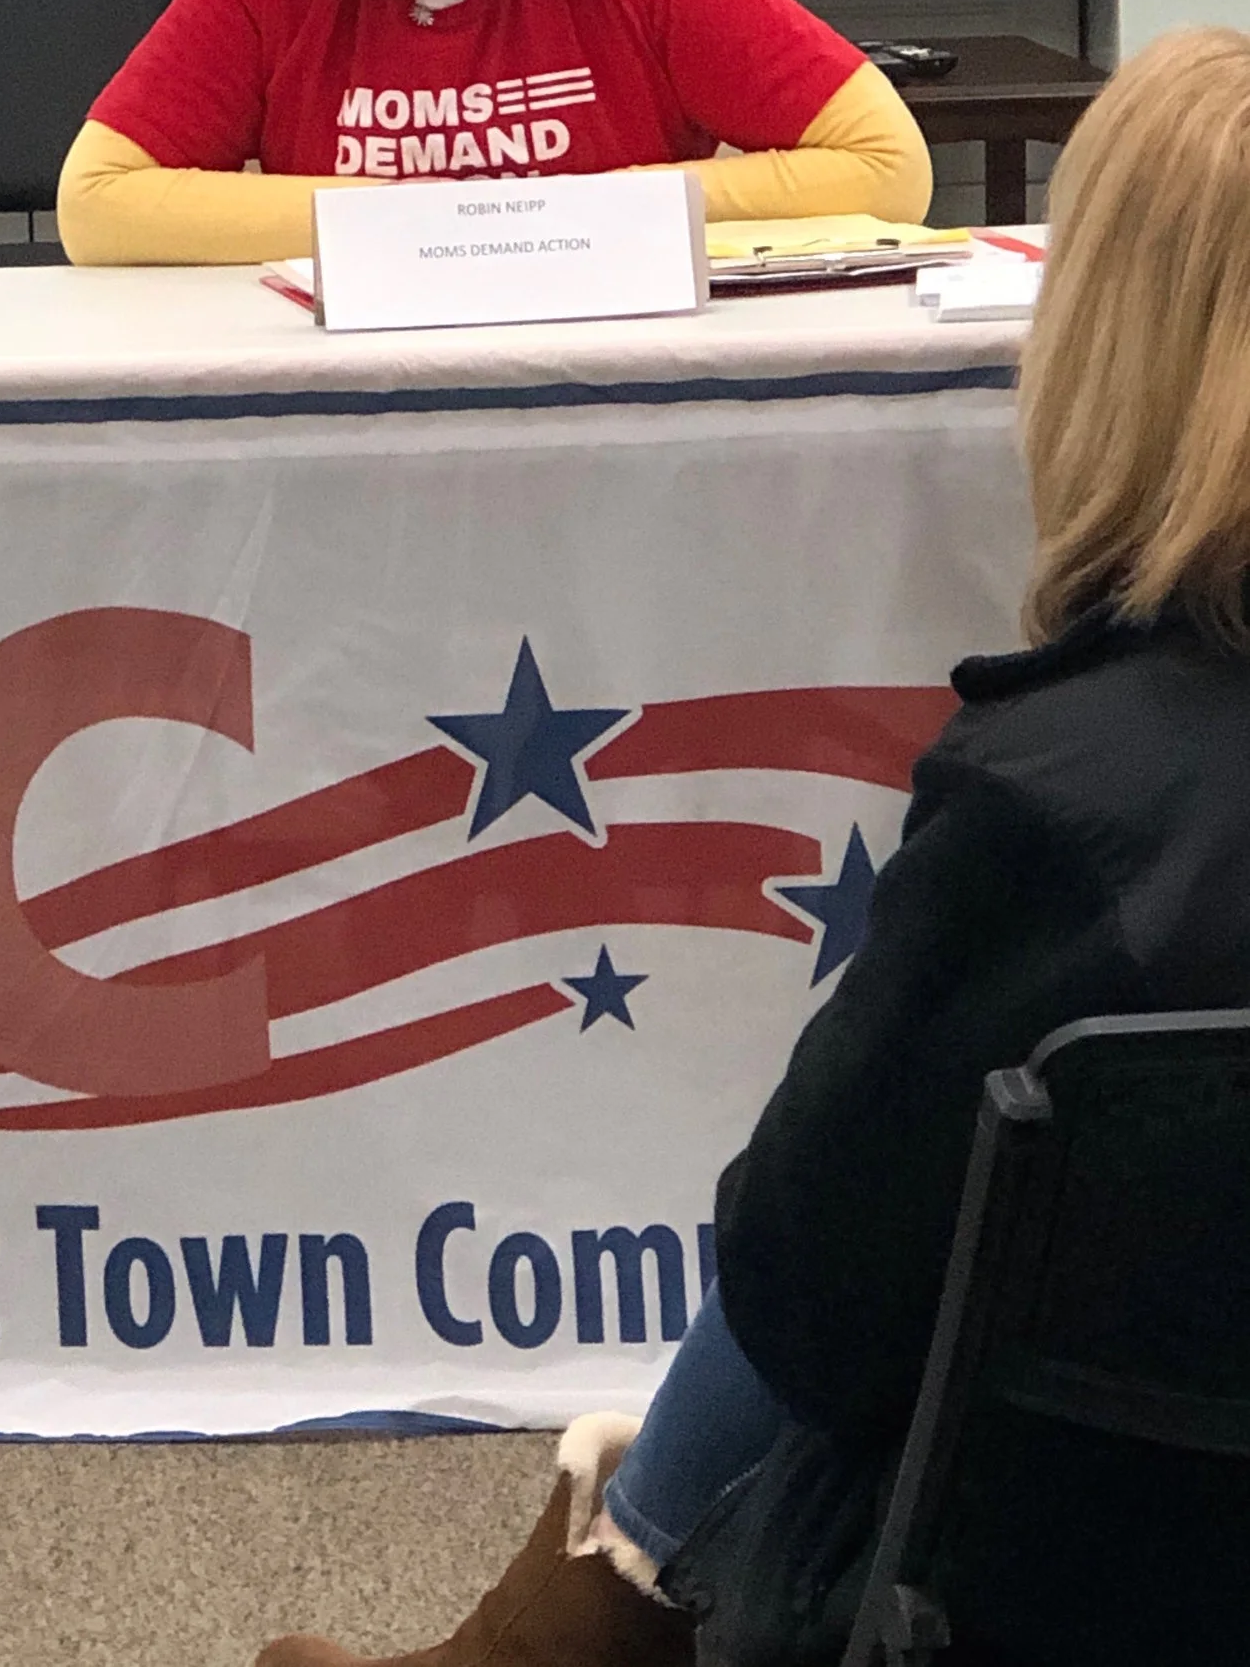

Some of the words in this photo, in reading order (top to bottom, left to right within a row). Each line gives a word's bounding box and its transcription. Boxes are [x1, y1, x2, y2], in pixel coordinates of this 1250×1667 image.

[337, 83, 494, 130] MOMS
[335, 118, 571, 176] DEMAND
[457, 201, 502, 216] ROBIN
[505, 199, 546, 213] NEIPP
[419, 244, 467, 259] MOMS
[470, 241, 535, 256] DEMAND
[538, 237, 591, 253] ACTION
[35, 1204, 373, 1349] Town
[415, 1201, 718, 1350] Com
